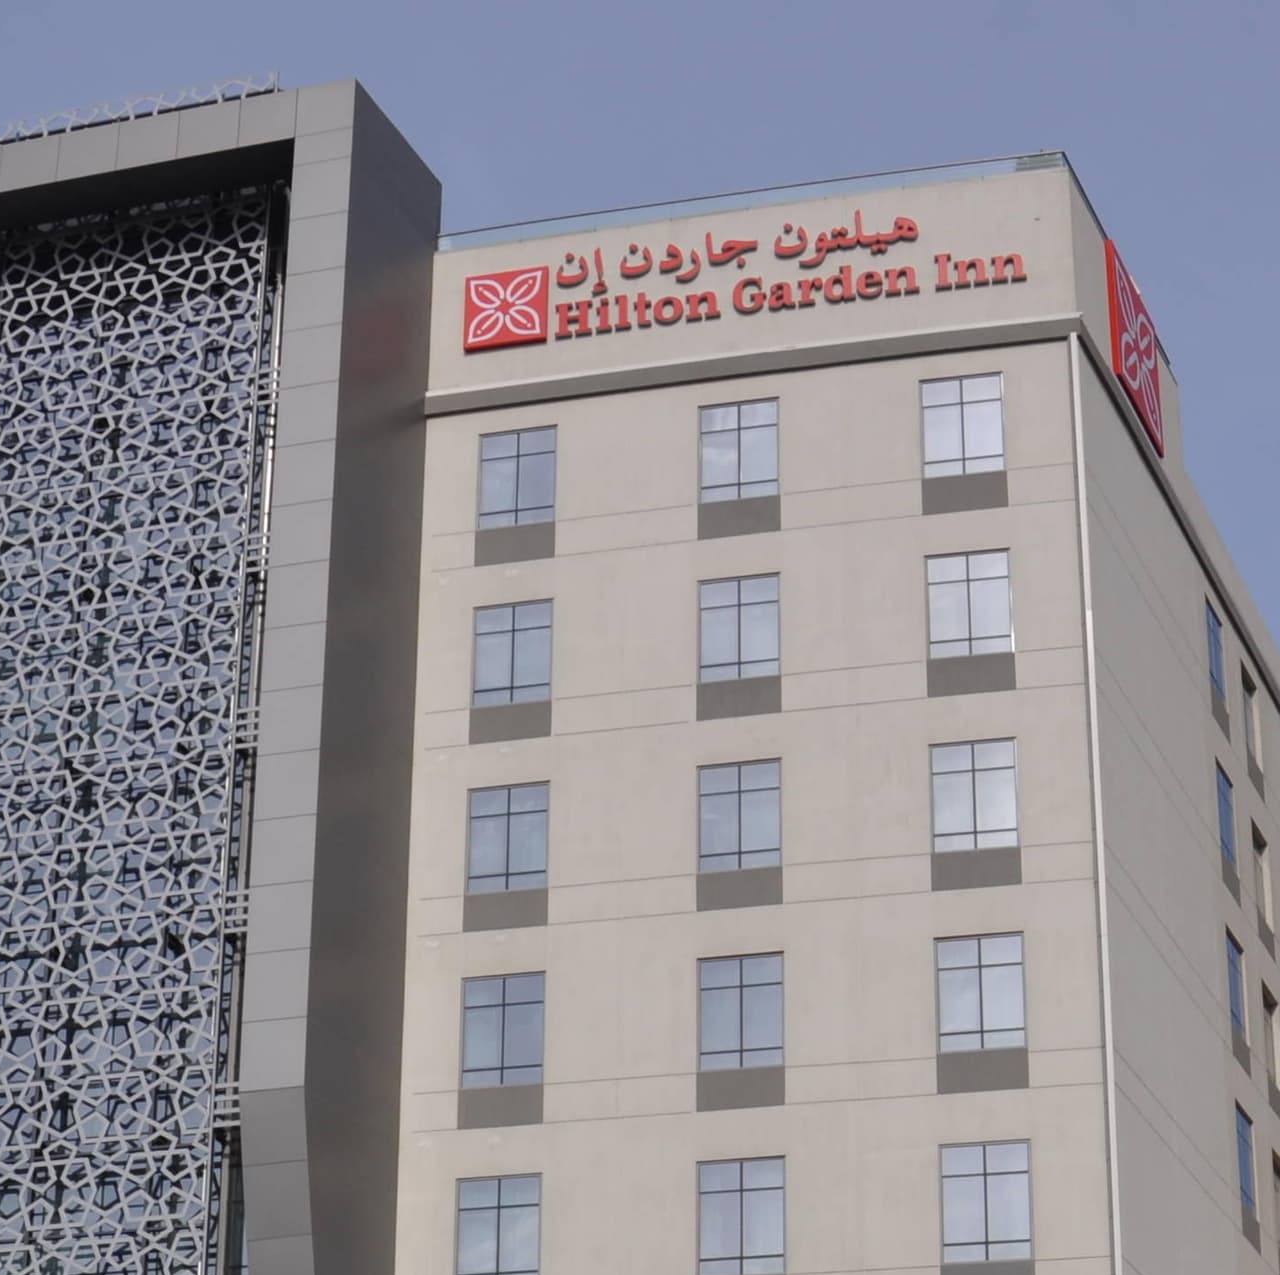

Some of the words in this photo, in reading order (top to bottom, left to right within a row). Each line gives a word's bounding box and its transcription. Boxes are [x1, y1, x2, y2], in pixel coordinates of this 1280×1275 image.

[620, 231, 758, 282] جاردن
[773, 209, 919, 267] هيلتون
[554, 290, 720, 338] Hilton
[732, 263, 919, 313] Garden
[934, 252, 1026, 291] Inn
[556, 247, 607, 293] إن
